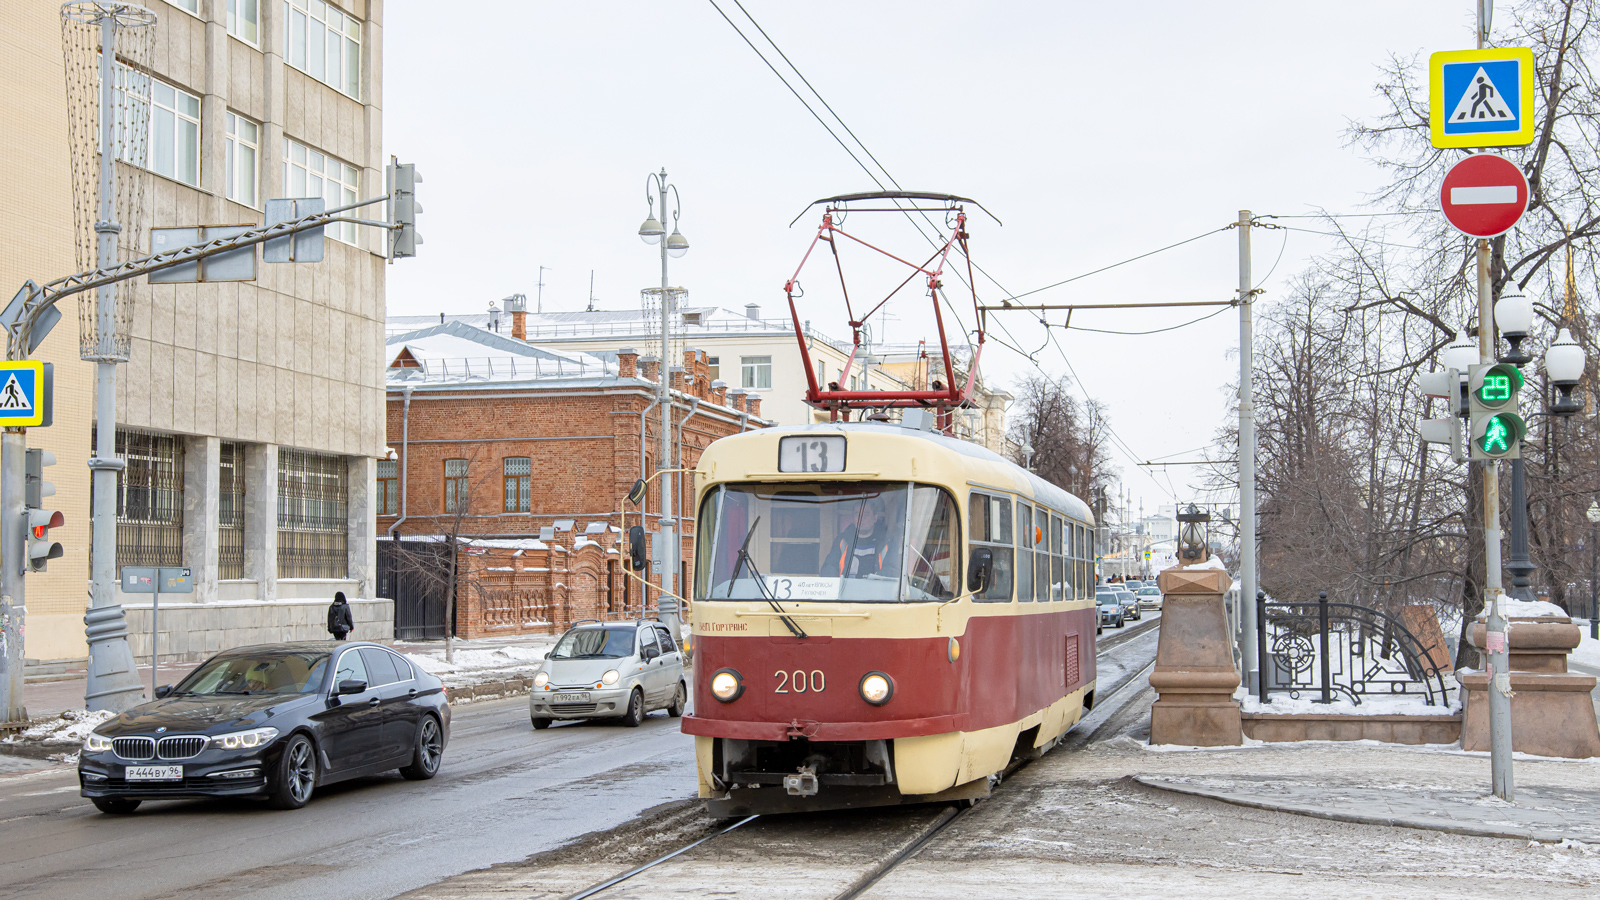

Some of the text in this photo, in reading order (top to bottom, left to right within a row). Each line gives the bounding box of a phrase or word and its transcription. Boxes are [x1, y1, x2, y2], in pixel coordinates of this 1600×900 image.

[1482, 376, 1509, 400] 29
[796, 441, 828, 472] 13
[773, 579, 792, 599] 13
[774, 669, 826, 694] 200
[169, 766, 179, 774] 96
